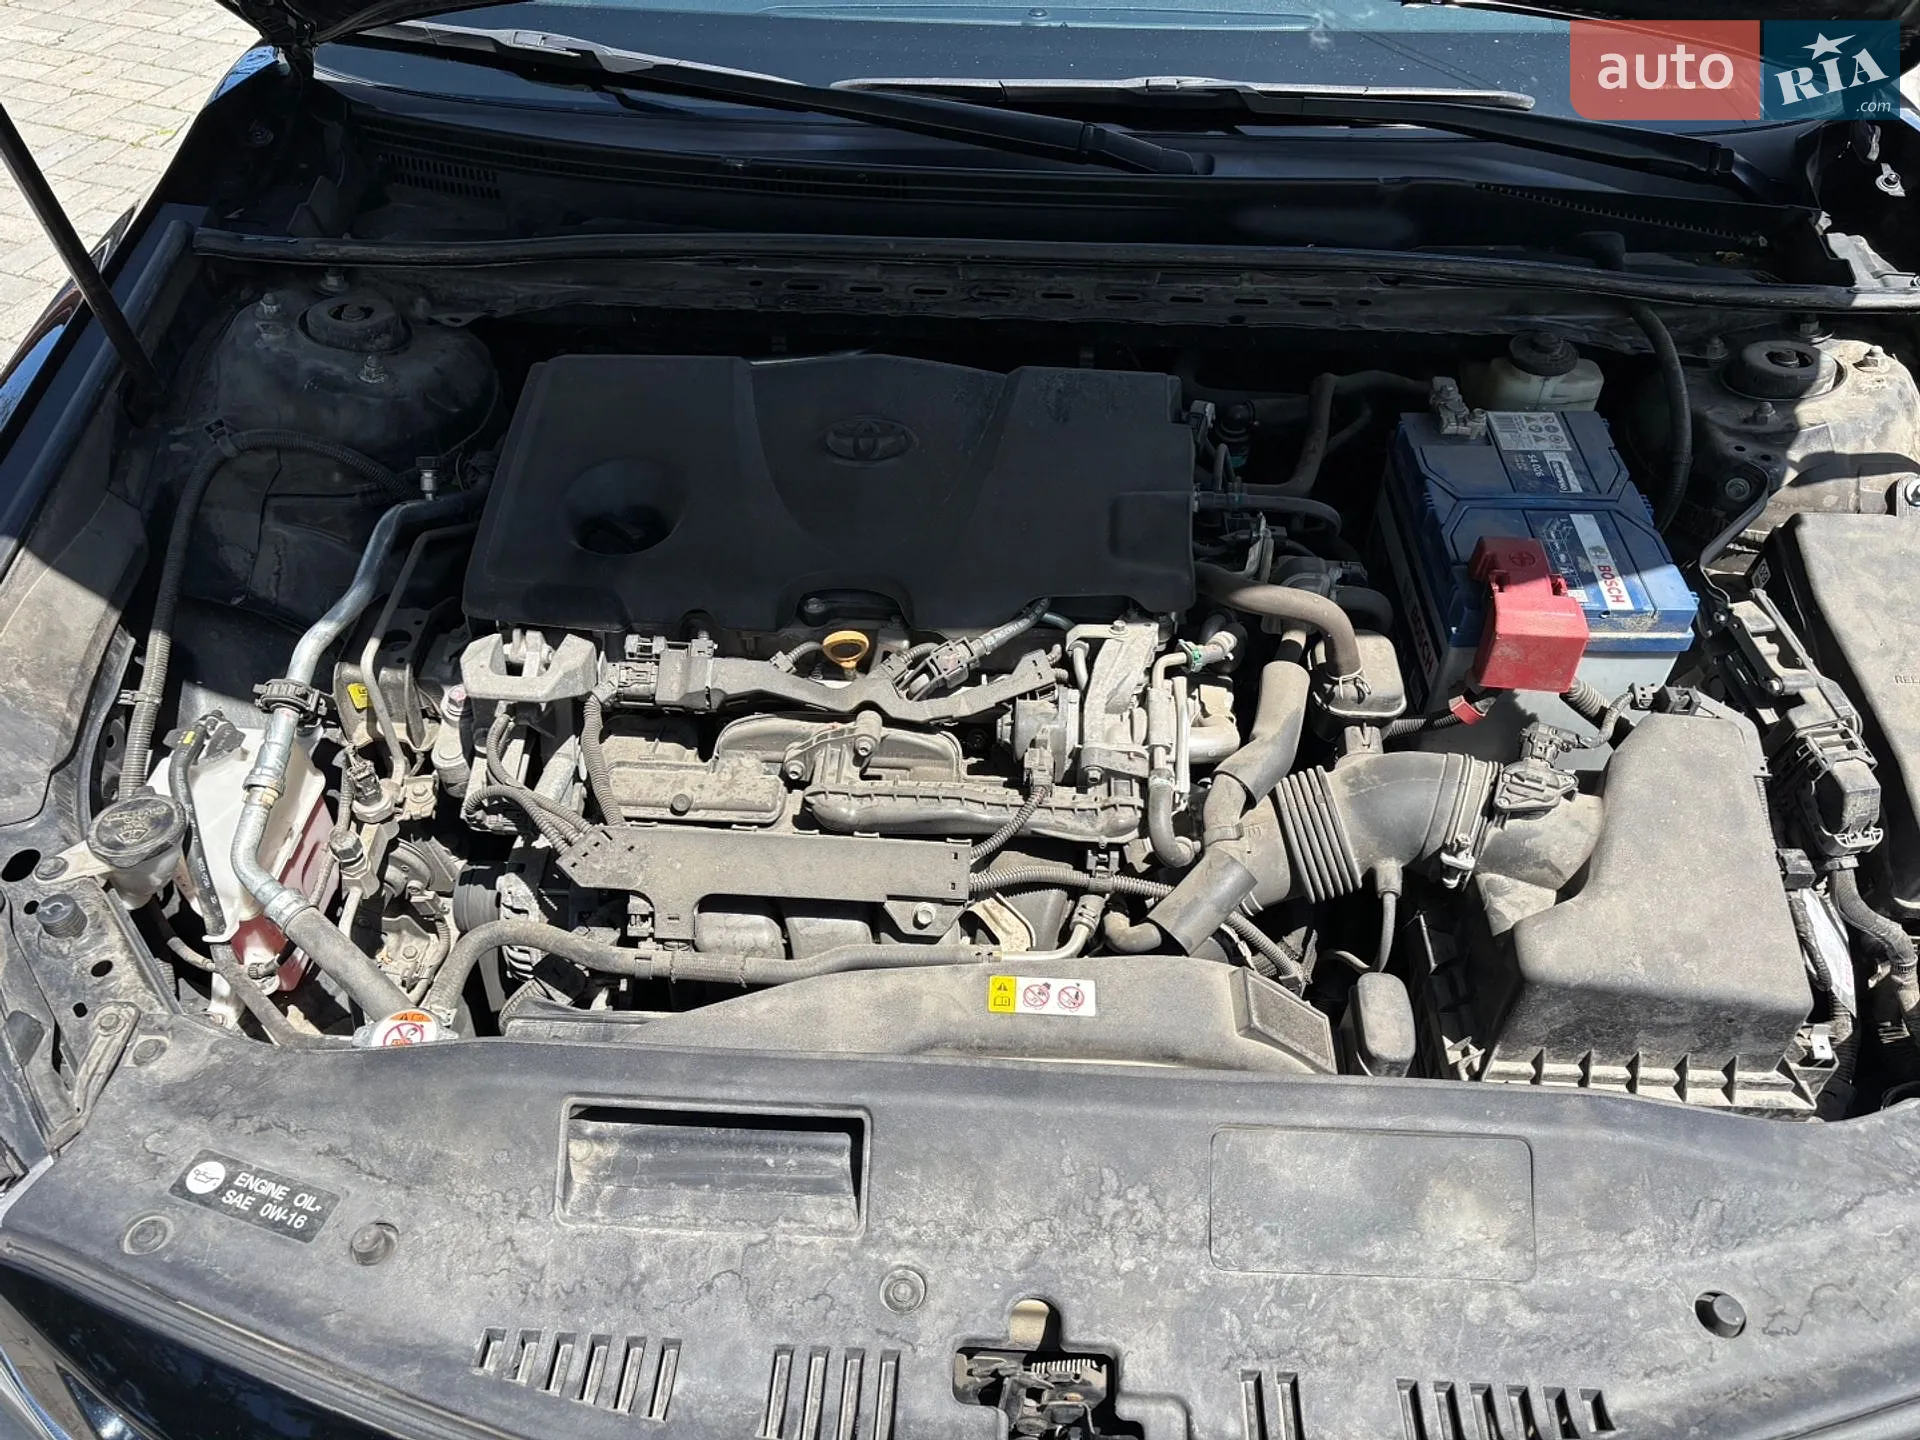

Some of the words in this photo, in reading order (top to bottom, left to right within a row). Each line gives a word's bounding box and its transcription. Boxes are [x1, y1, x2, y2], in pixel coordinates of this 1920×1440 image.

[1597, 565, 1626, 604] BOSCH
[233, 1172, 291, 1201] ENGINE
[221, 1189, 256, 1211] SAE
[259, 1203, 308, 1229] 0W-16
